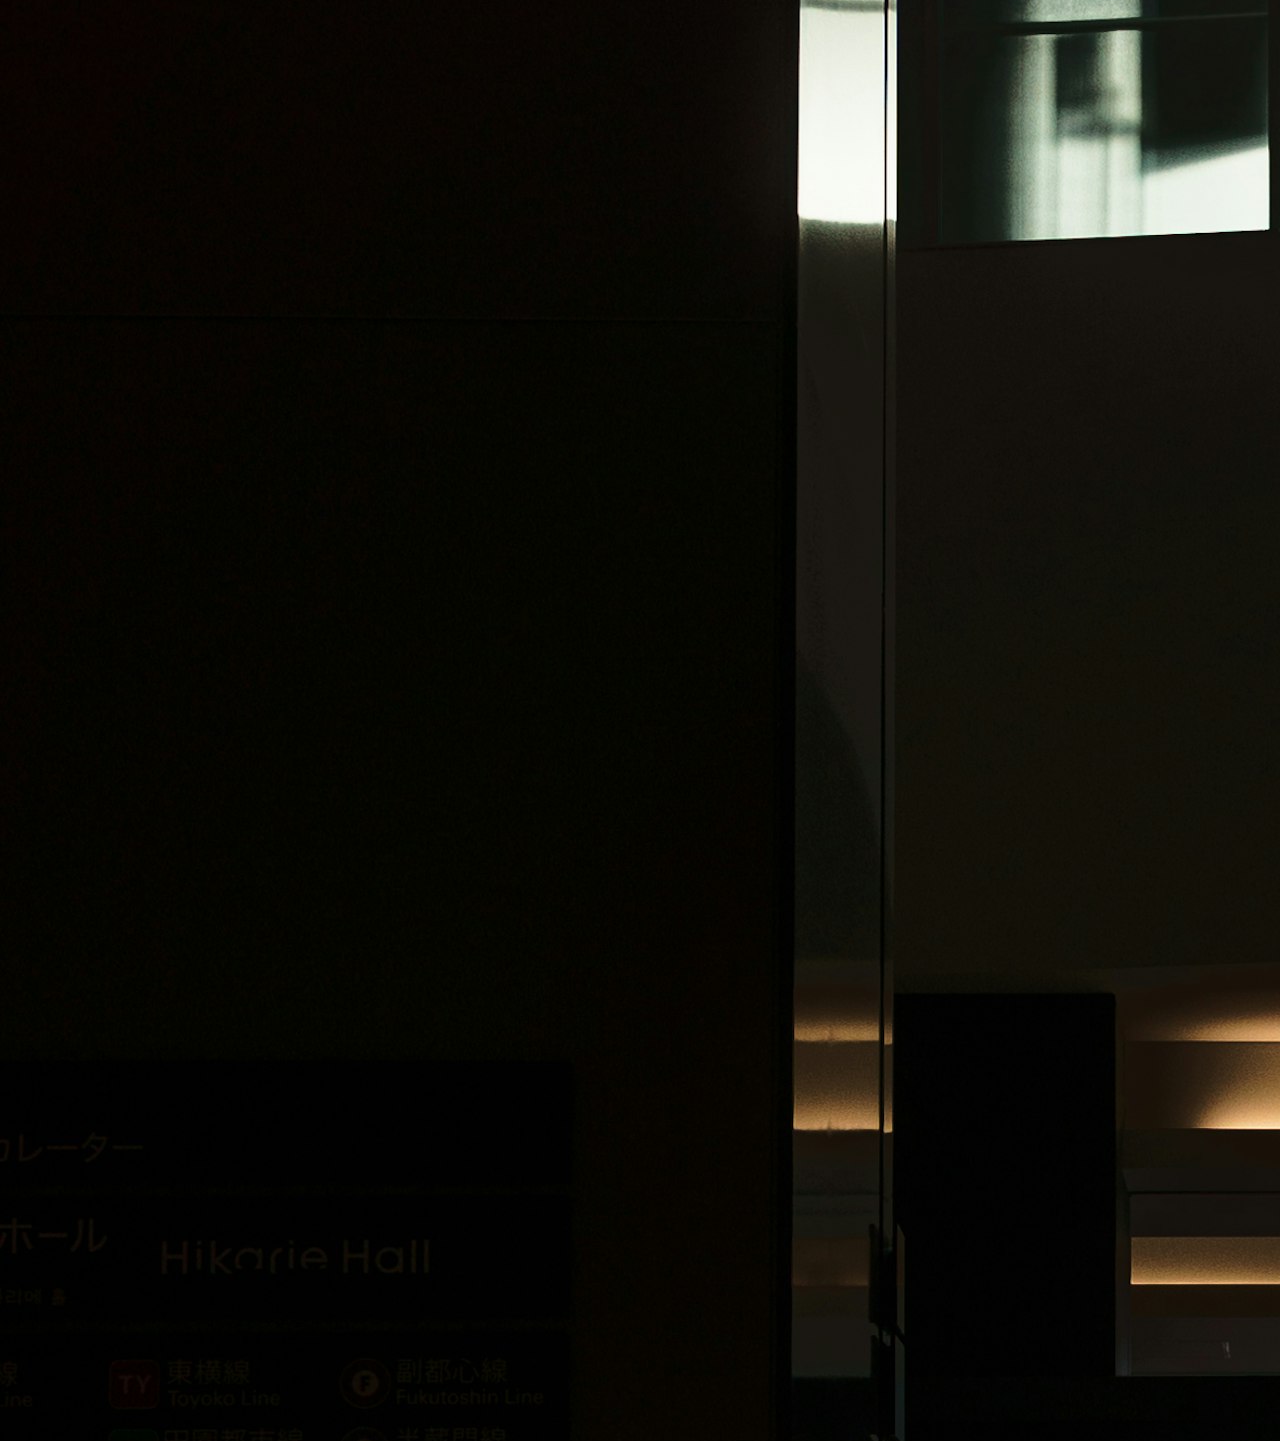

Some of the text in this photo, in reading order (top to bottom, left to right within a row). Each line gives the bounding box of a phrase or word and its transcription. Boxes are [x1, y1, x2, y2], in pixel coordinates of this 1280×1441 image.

[0, 1217, 107, 1254] ホール
[160, 1239, 431, 1275] Hikarie Hall
[167, 1357, 250, 1384] 東横線
[396, 1357, 508, 1384] 副都心線
[118, 1375, 152, 1395] TY
[396, 1387, 545, 1405] Fukutoshin Line
[167, 1389, 281, 1410] Toyoko Line
